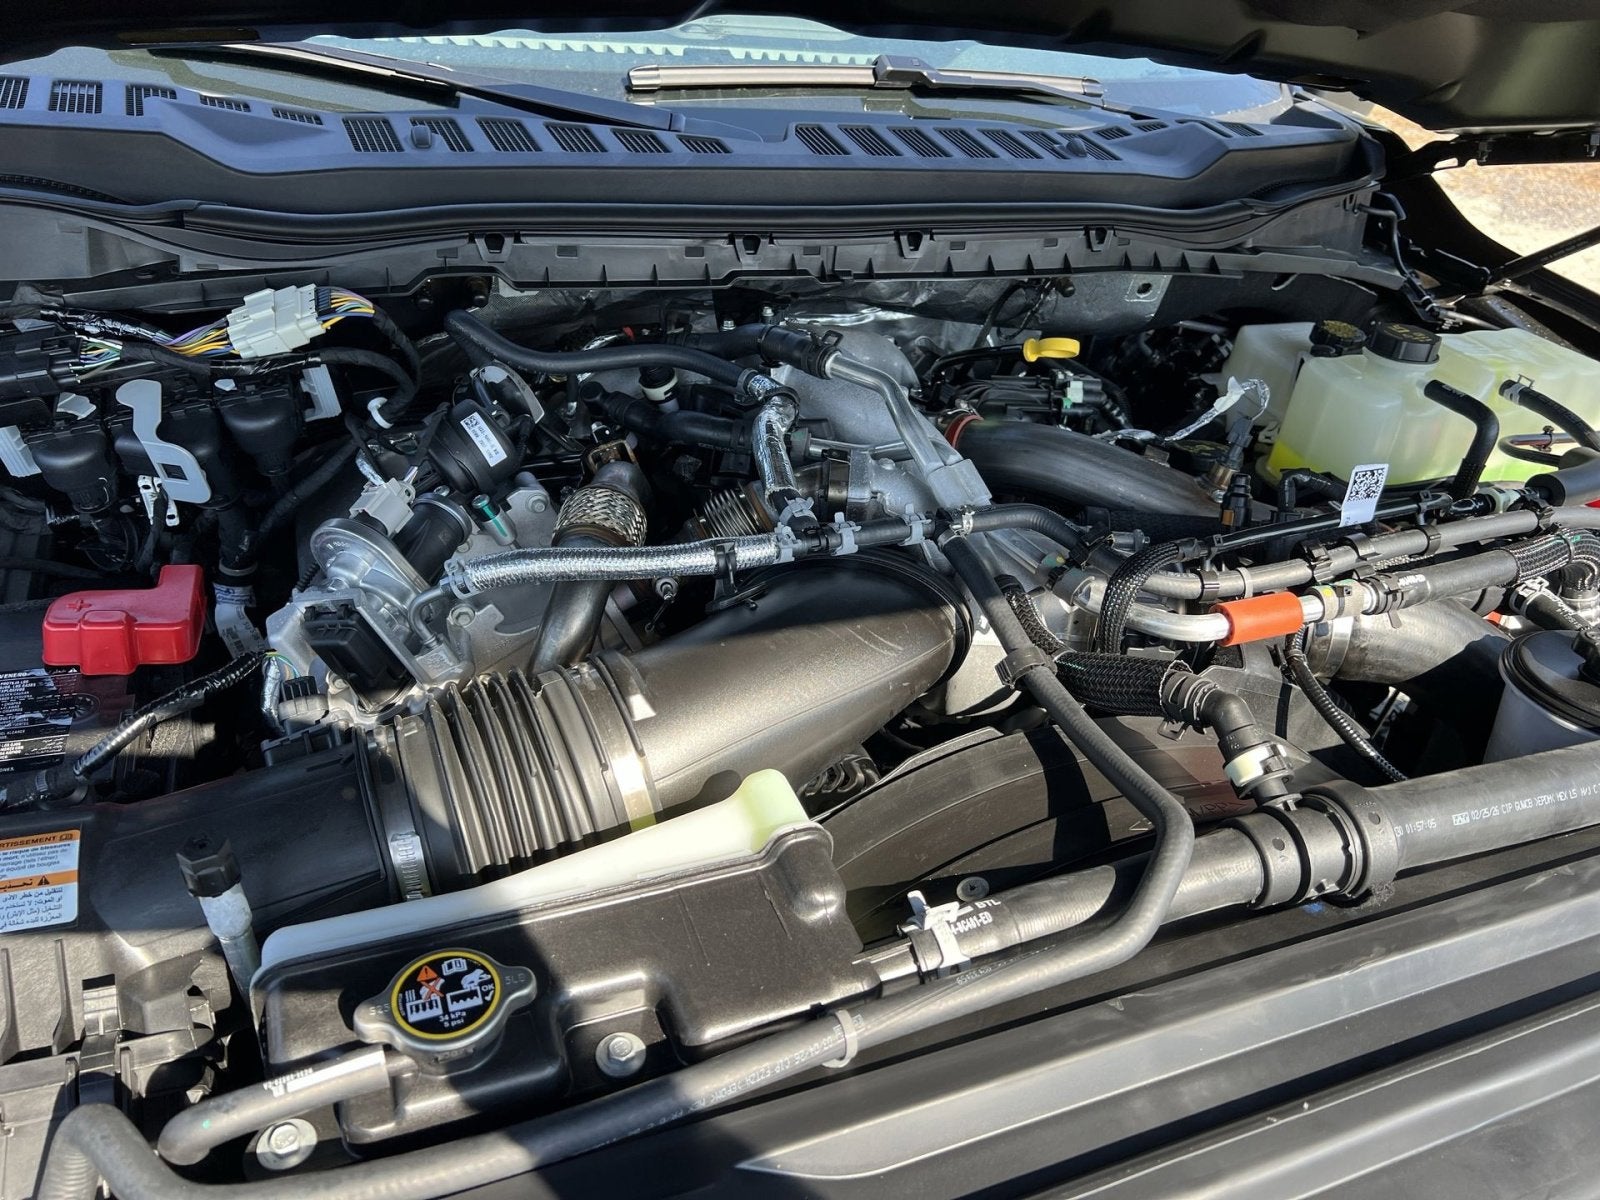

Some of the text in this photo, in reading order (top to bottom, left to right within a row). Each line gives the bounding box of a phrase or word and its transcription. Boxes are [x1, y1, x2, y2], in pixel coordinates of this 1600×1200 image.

[974, 899, 1001, 909] BTL
[481, 984, 495, 992] OK
[451, 1010, 467, 1021] kPa
[450, 1018, 464, 1028] psi
